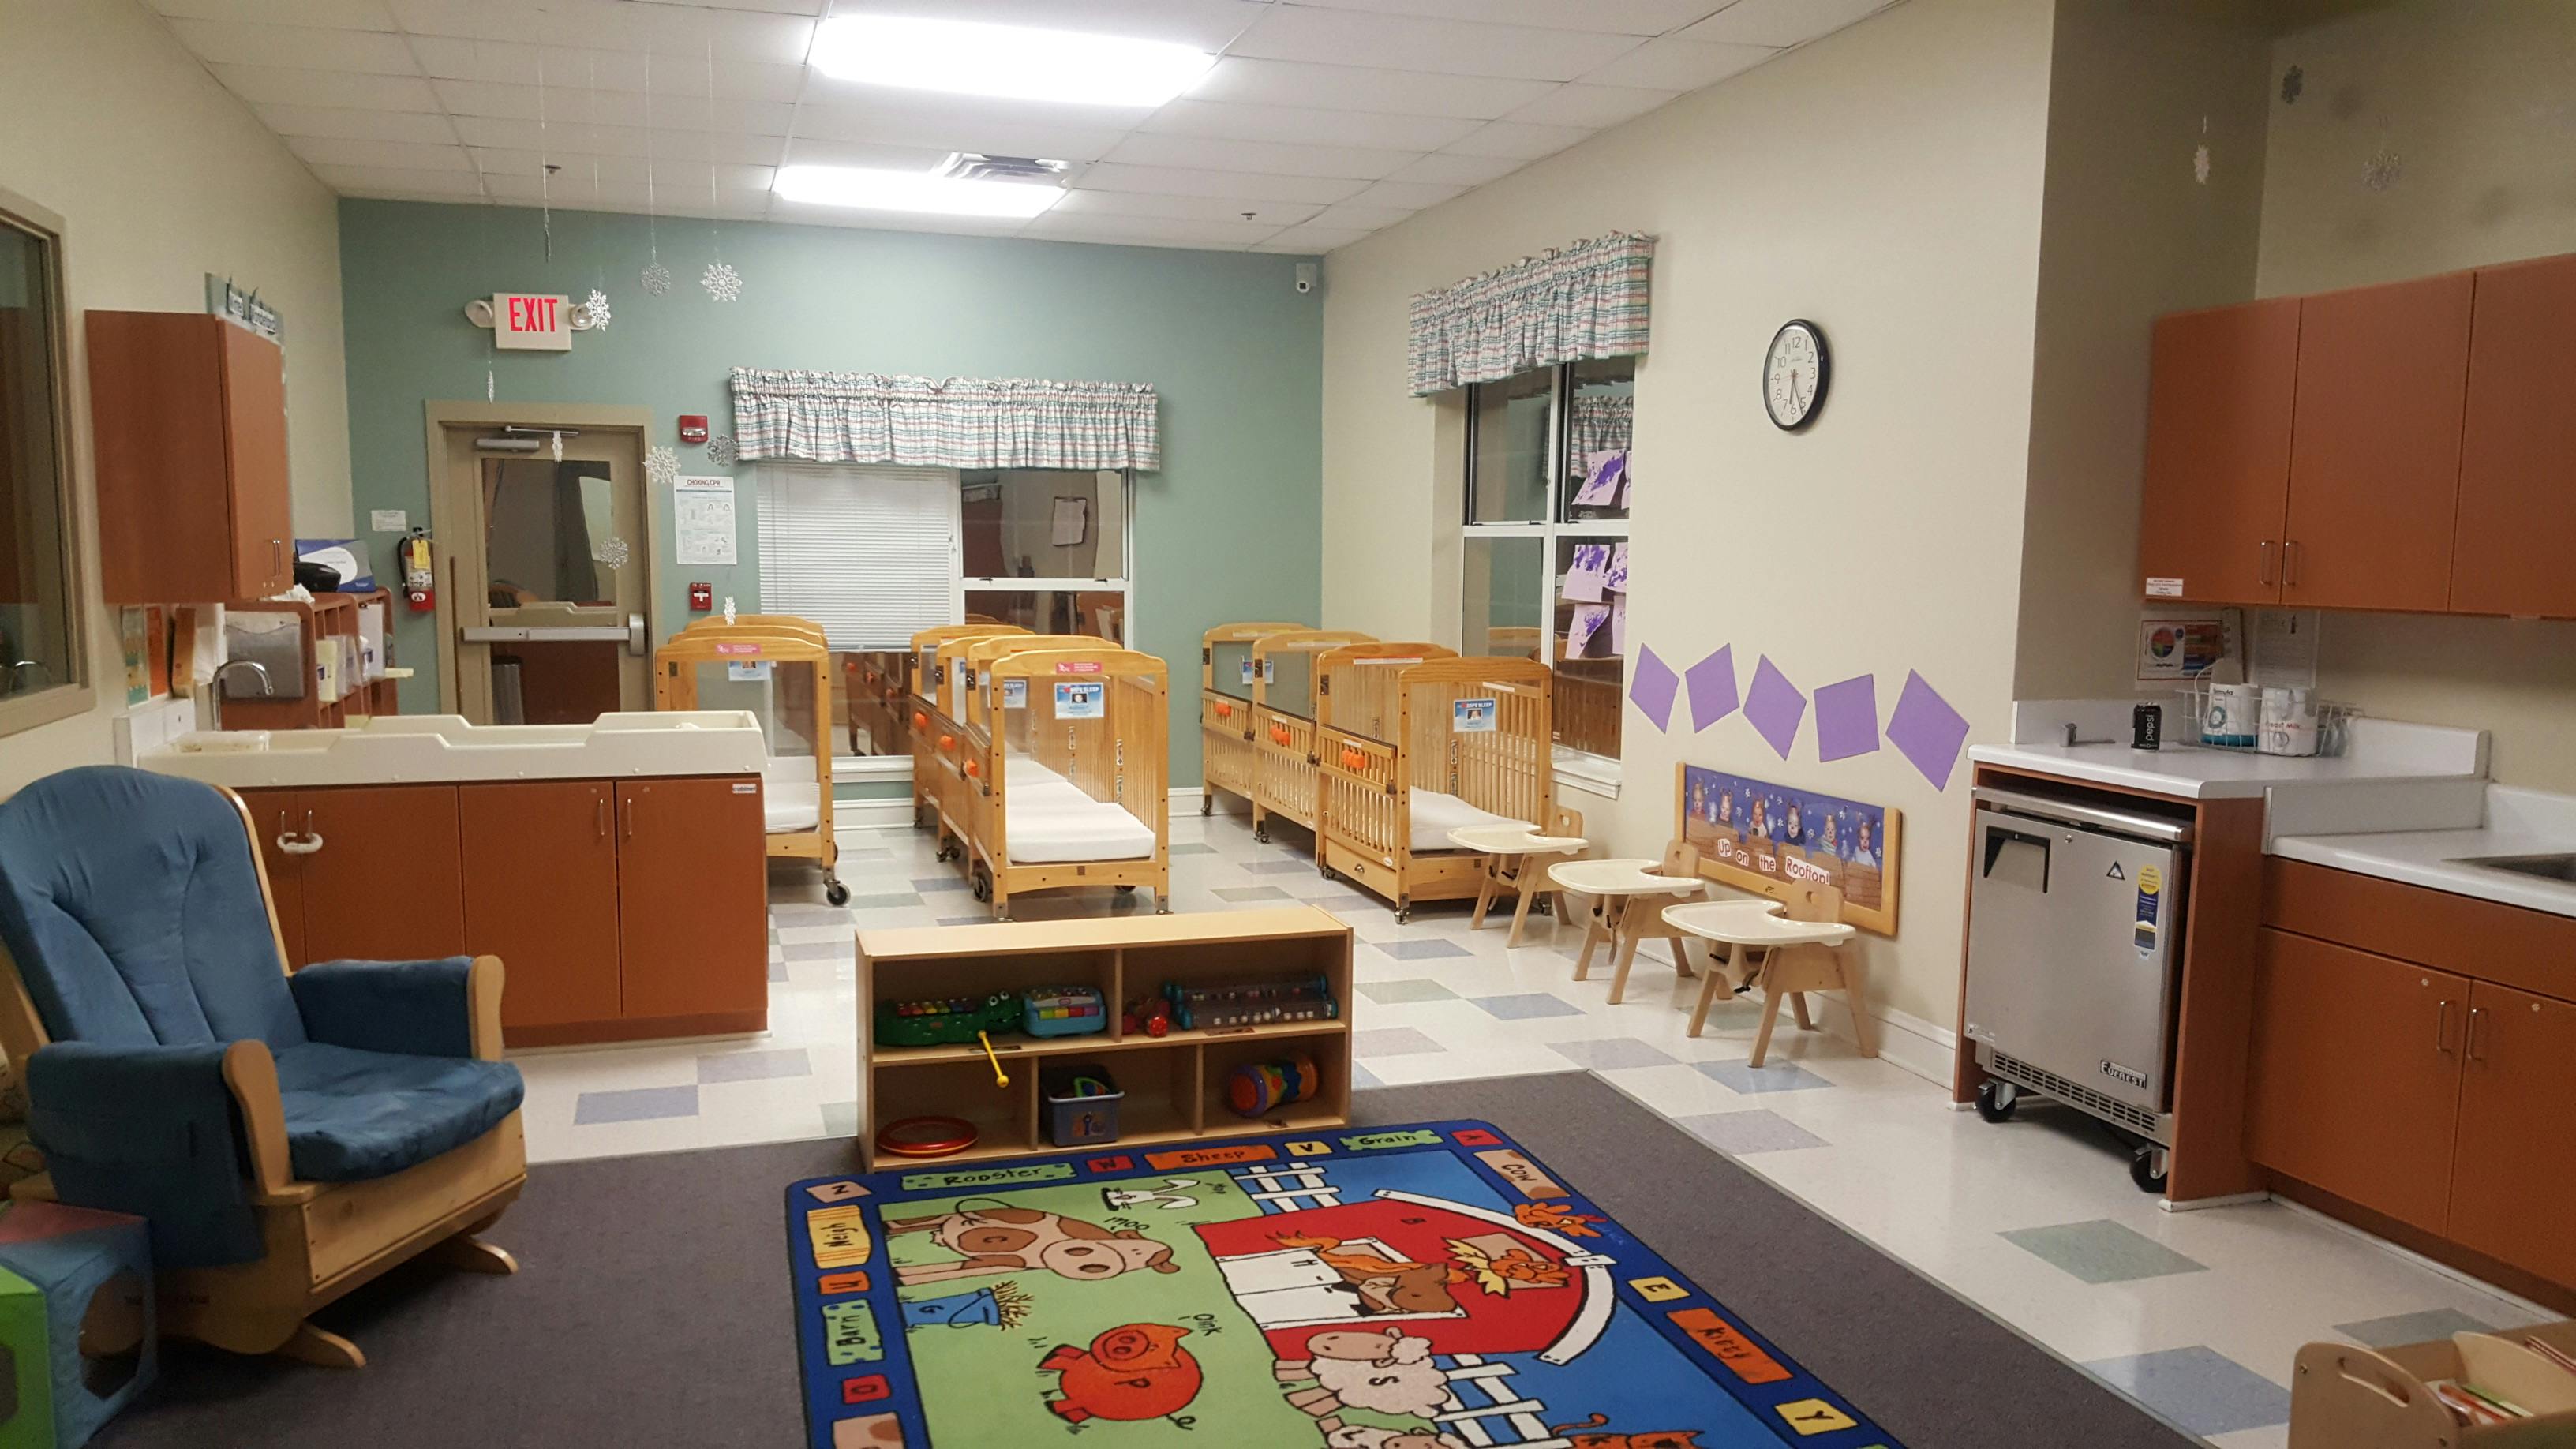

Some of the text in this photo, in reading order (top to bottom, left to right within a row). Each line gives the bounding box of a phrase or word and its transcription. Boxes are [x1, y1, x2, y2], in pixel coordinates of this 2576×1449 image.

[509, 298, 557, 331] EXIT
[1792, 336, 1801, 348] 12
[1785, 343, 1791, 354] 11
[1777, 356, 1786, 368] 10
[1807, 352, 1814, 364] 2
[1774, 373, 1780, 384] 9
[1810, 367, 1816, 379] 3
[1776, 388, 1782, 400] 8
[1807, 384, 1814, 395] 4
[1783, 399, 1788, 411] 7
[1800, 397, 1807, 409] 5
[1790, 404, 1797, 415] 6
[2145, 714, 2156, 742] pepsi
[1718, 841, 1731, 856] Up
[1736, 852, 1748, 865] on
[1760, 856, 1775, 871] the
[1359, 1133, 1417, 1145] Grain
[1299, 1143, 1313, 1152] V
[1181, 1149, 1245, 1164] Sheep
[943, 1166, 1043, 1186] Rooster
[1500, 1163, 1538, 1182] Cow
[822, 1222, 859, 1248] Neigh
[1643, 1282, 1670, 1293] E
[835, 1313, 867, 1347] Barn
[1193, 1313, 1222, 1337] Oink
[1698, 1326, 1751, 1361] Kitty
[1114, 1377, 1151, 1389] P
[1368, 1375, 1400, 1387] S
[1795, 1410, 1835, 1422] Y
